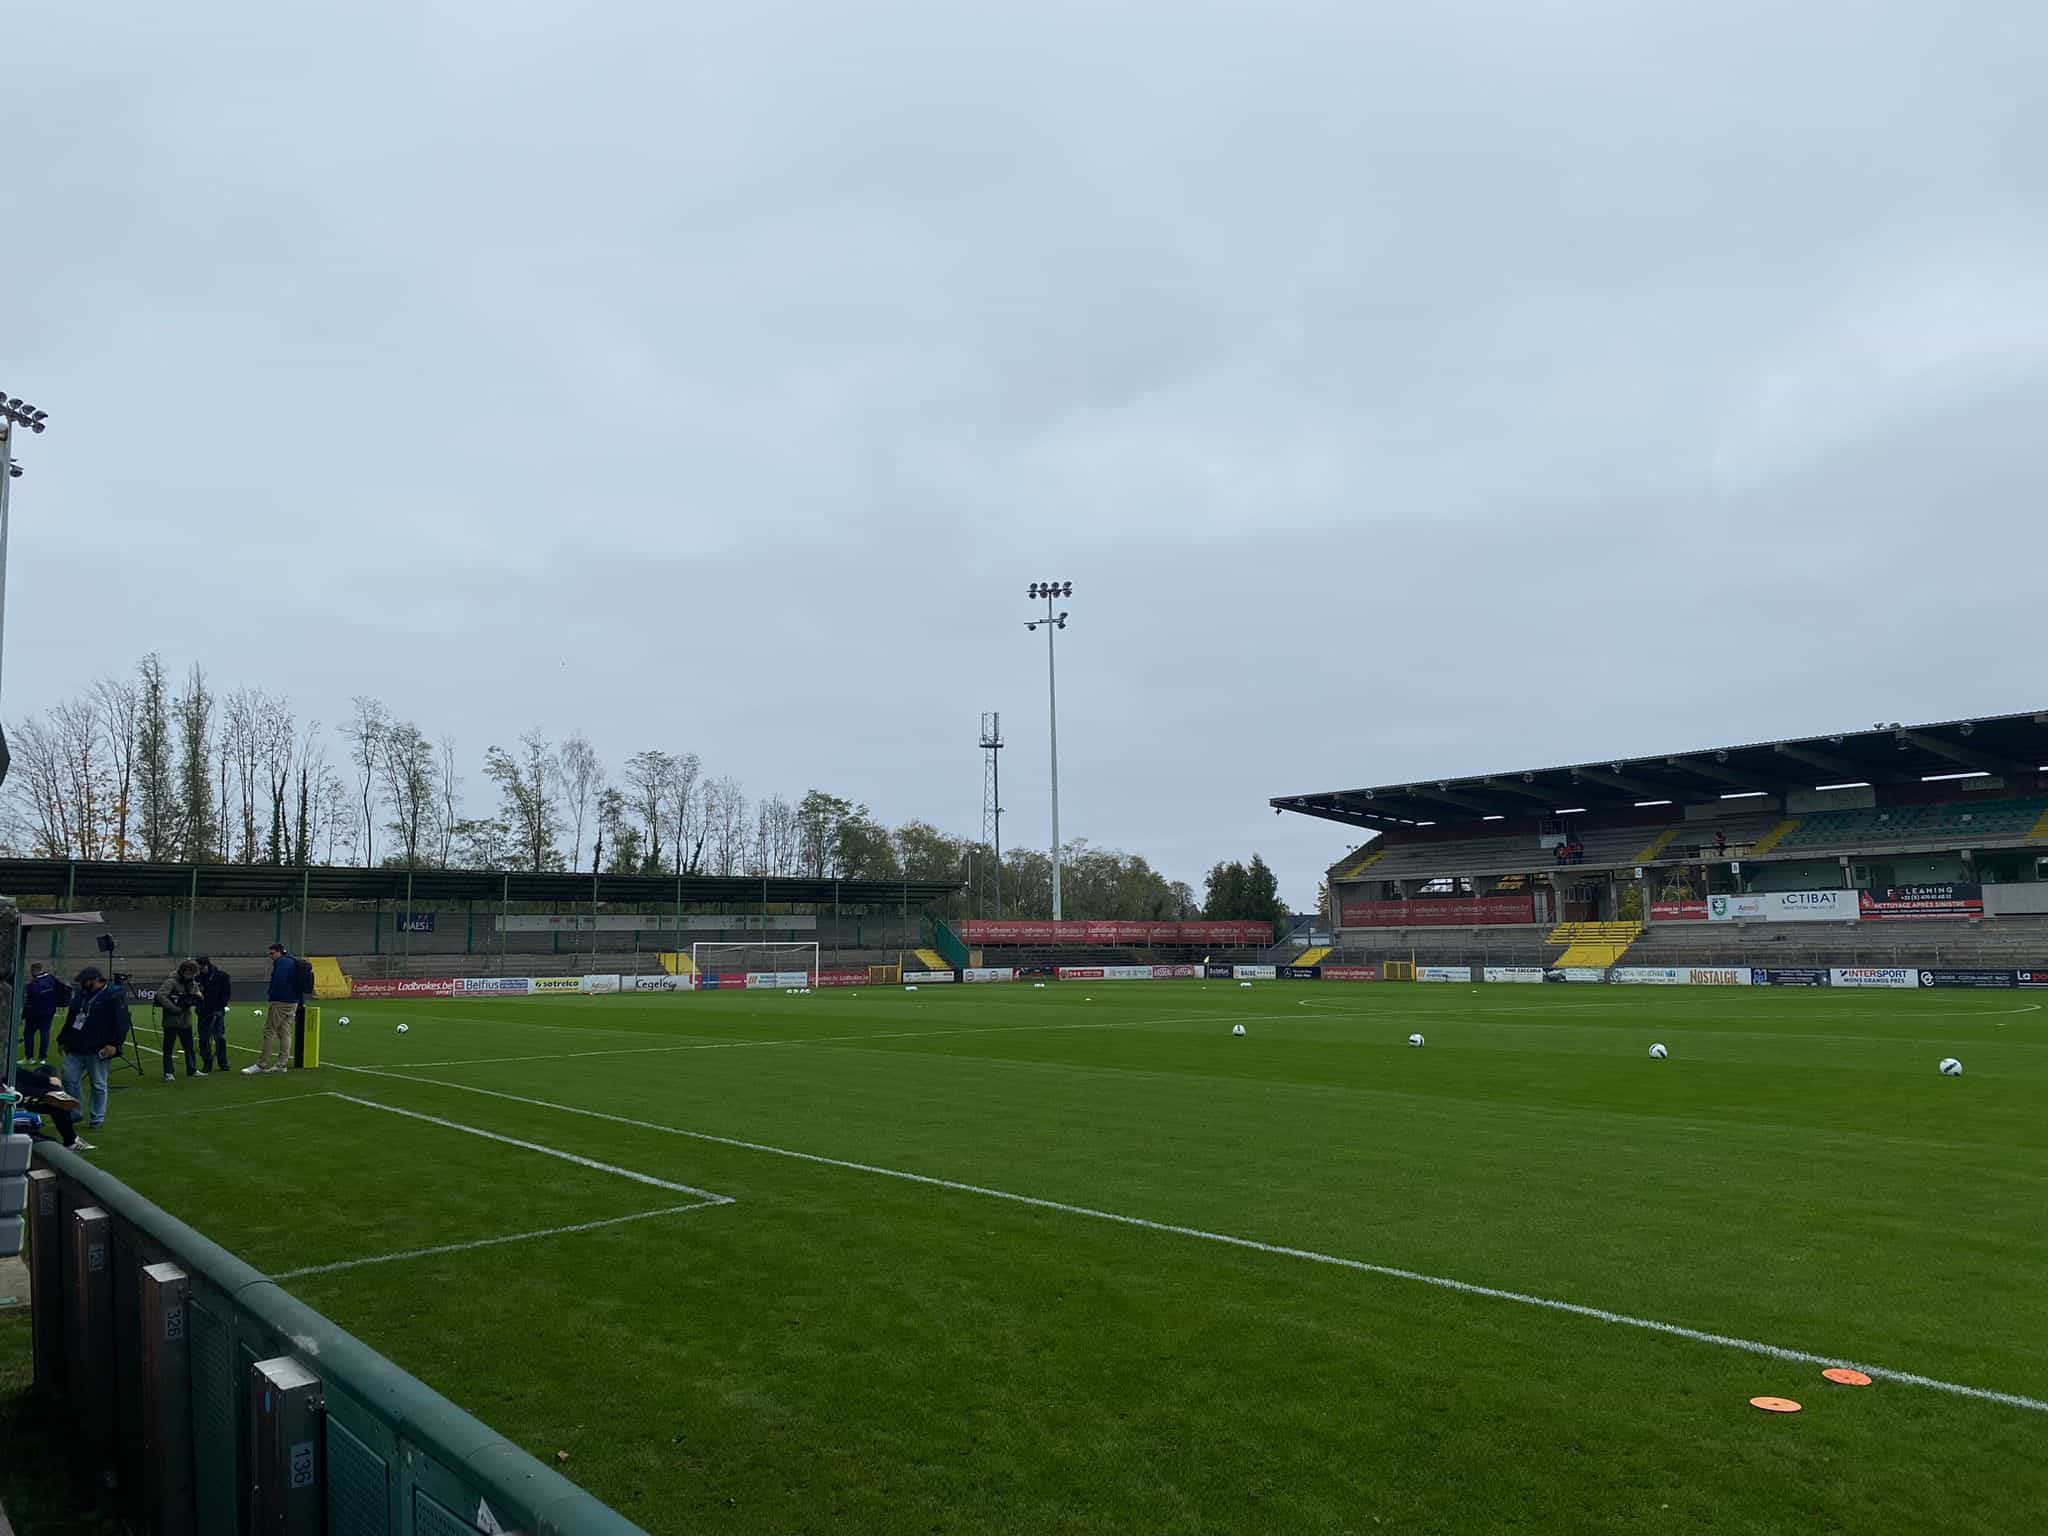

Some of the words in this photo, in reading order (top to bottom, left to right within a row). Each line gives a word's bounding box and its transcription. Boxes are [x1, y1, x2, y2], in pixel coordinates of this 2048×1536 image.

[1782, 893, 1838, 904] CTIBAT
[1689, 969, 1739, 984] NOSTALGIE
[1848, 970, 1907, 978] INTERSPORT
[2016, 970, 2031, 980] La
[398, 981, 454, 991] Ladbrokes.be
[466, 979, 500, 990] Belfius
[295, 1448, 312, 1484] 136
